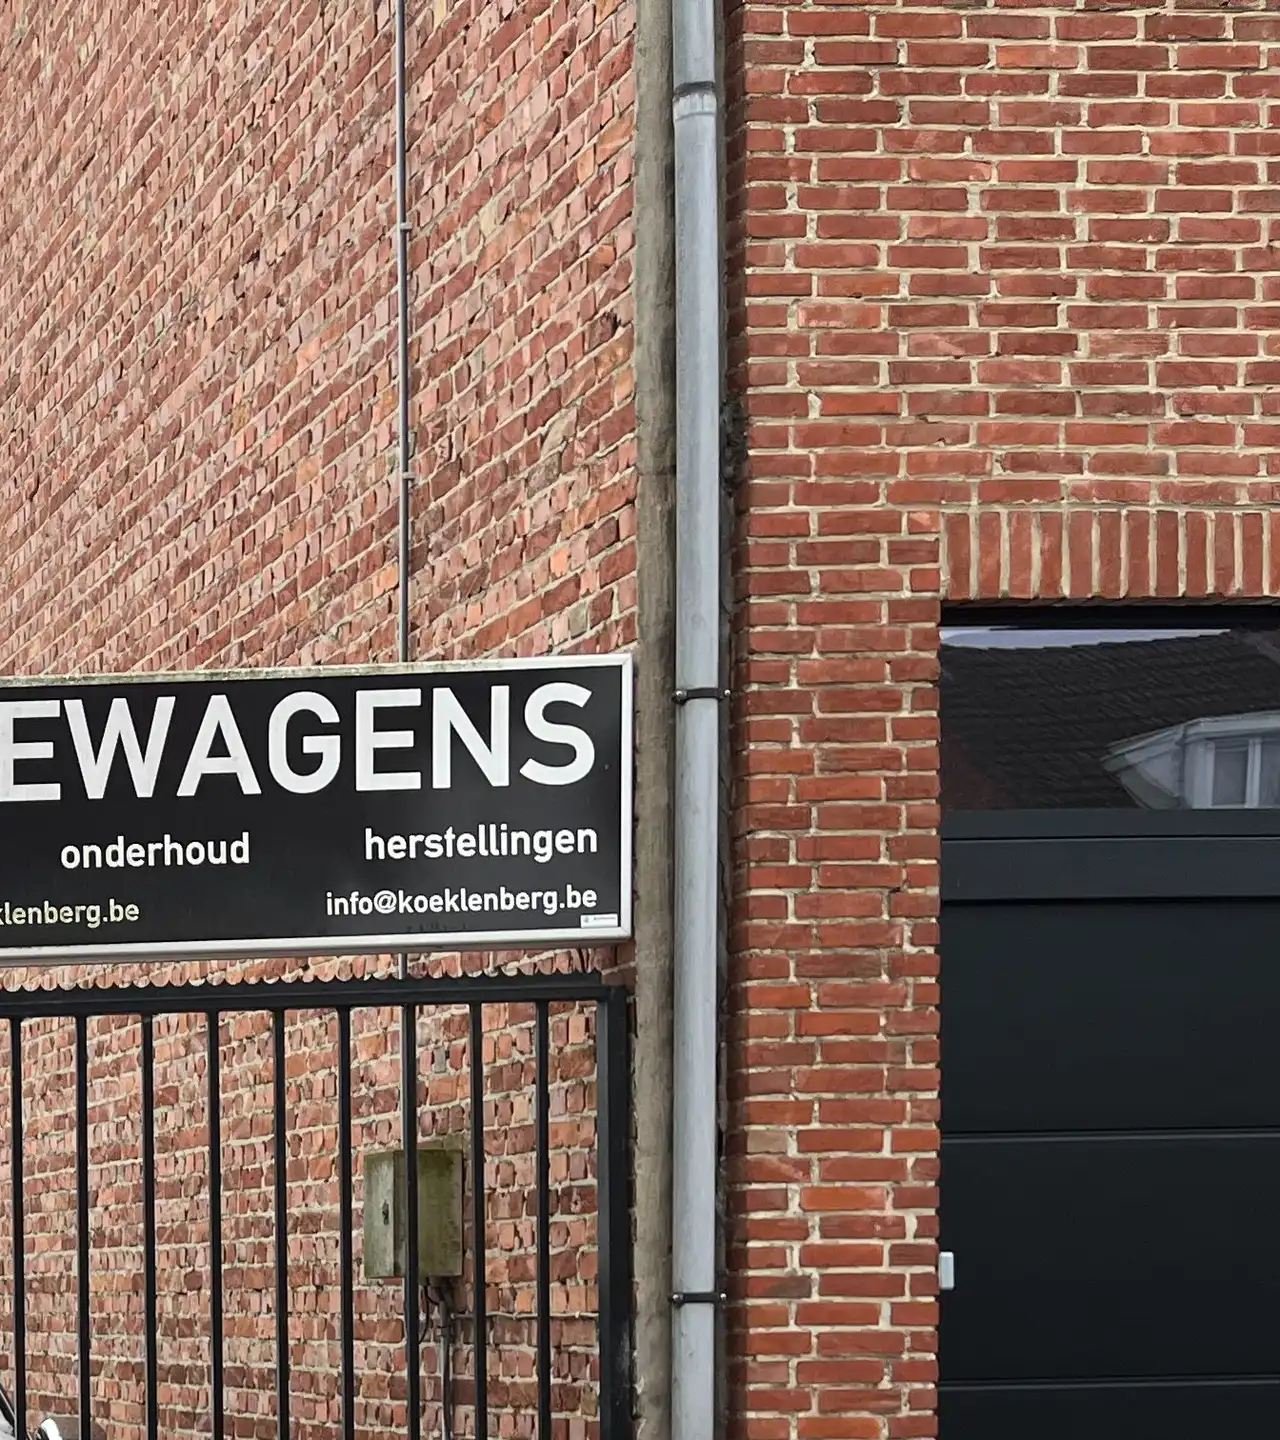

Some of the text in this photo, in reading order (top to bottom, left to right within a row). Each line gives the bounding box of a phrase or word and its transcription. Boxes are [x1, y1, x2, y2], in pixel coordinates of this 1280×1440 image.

[60, 831, 251, 869] onderhoud
[365, 823, 598, 864] herstellingen
[326, 884, 598, 916] info@koeklenberg.be
